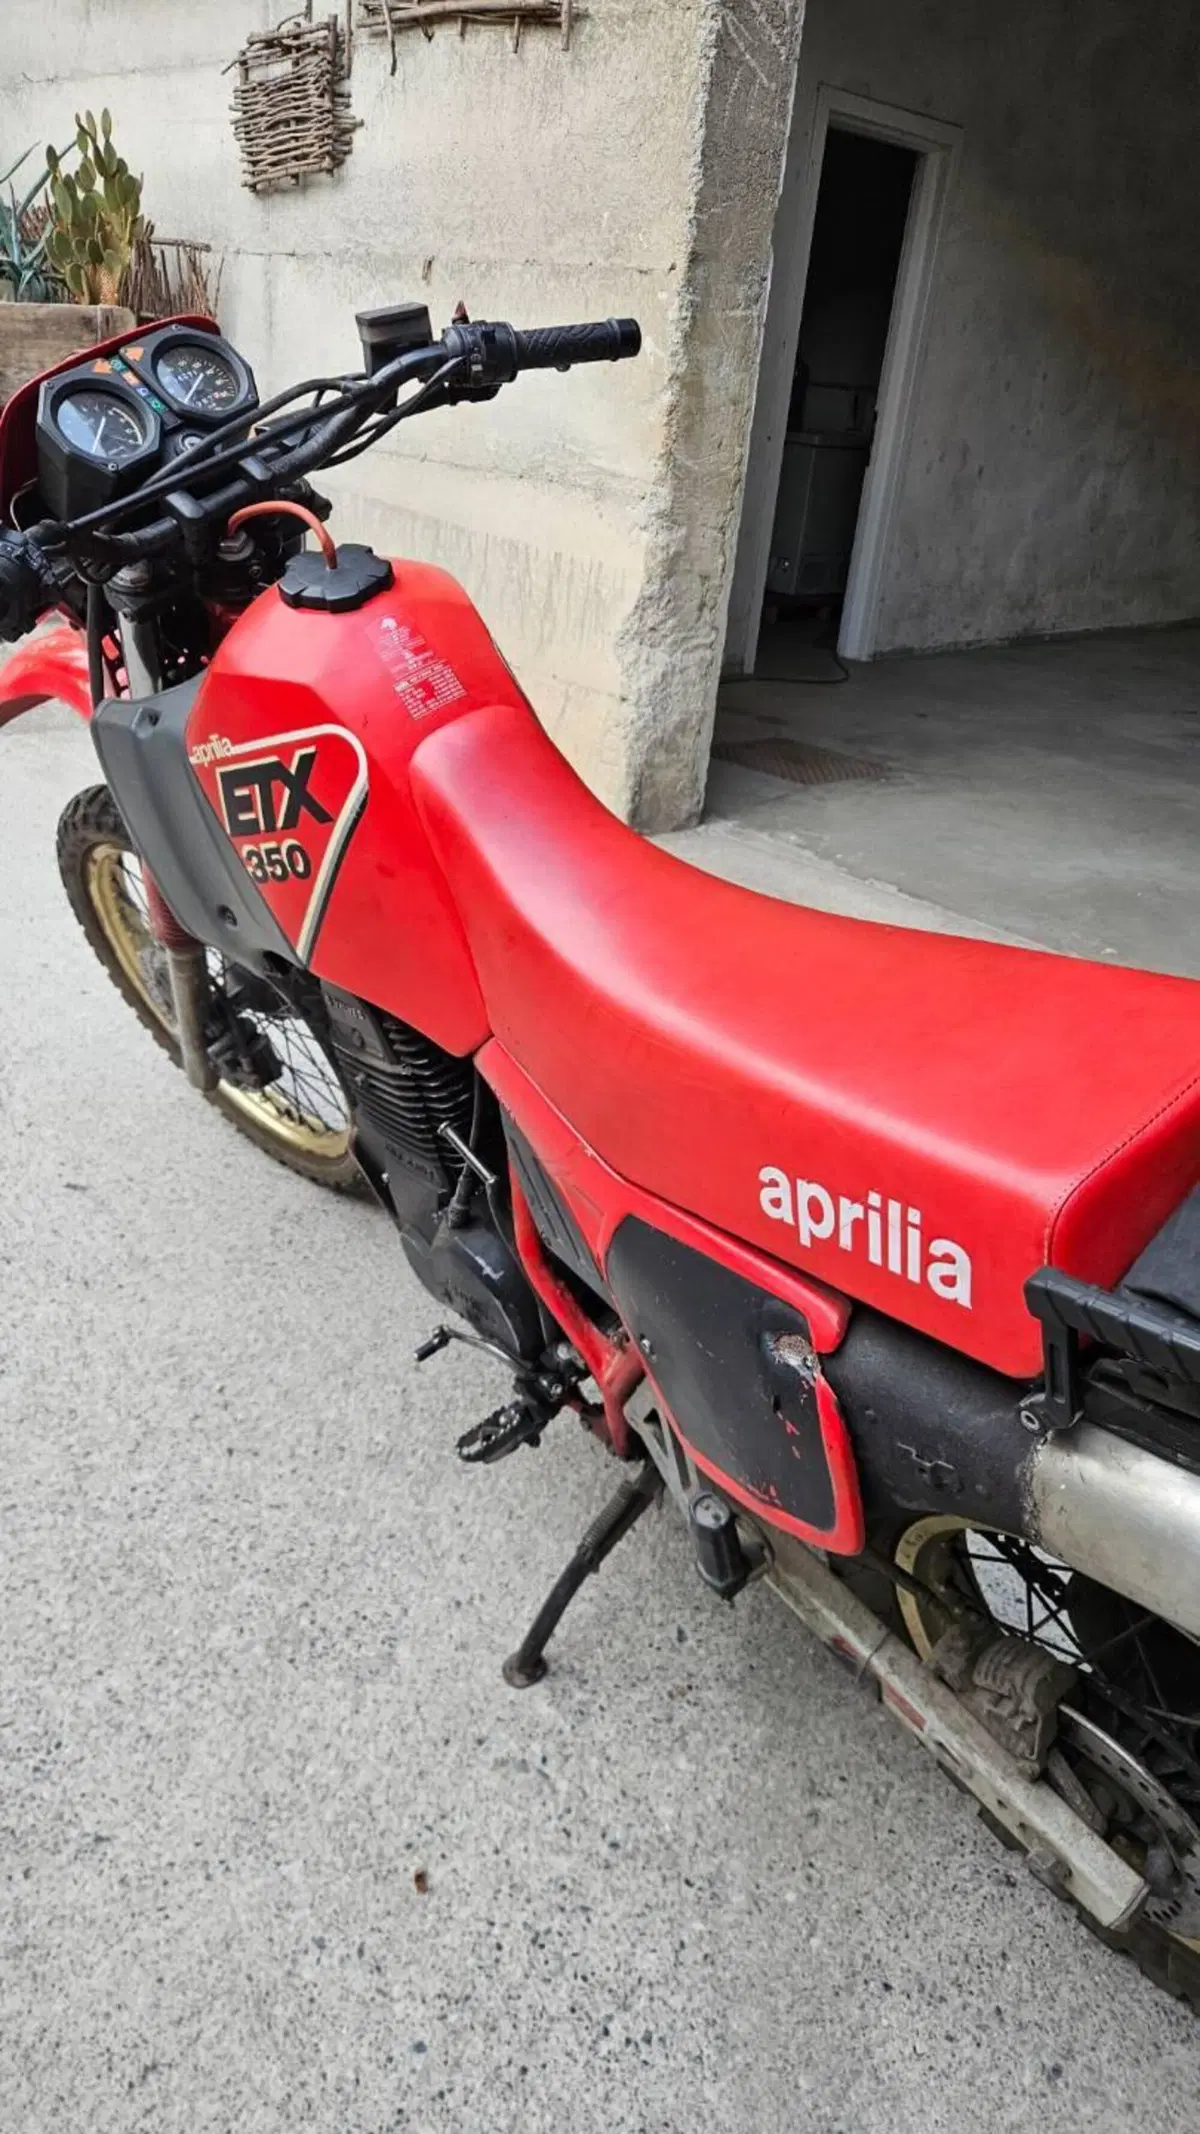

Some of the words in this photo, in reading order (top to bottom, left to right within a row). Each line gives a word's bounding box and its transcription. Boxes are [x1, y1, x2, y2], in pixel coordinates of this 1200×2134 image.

[192, 733, 232, 767] aprilia
[216, 744, 334, 837] ETX
[242, 838, 311, 884] 350
[758, 1165, 972, 1310] aprilia
